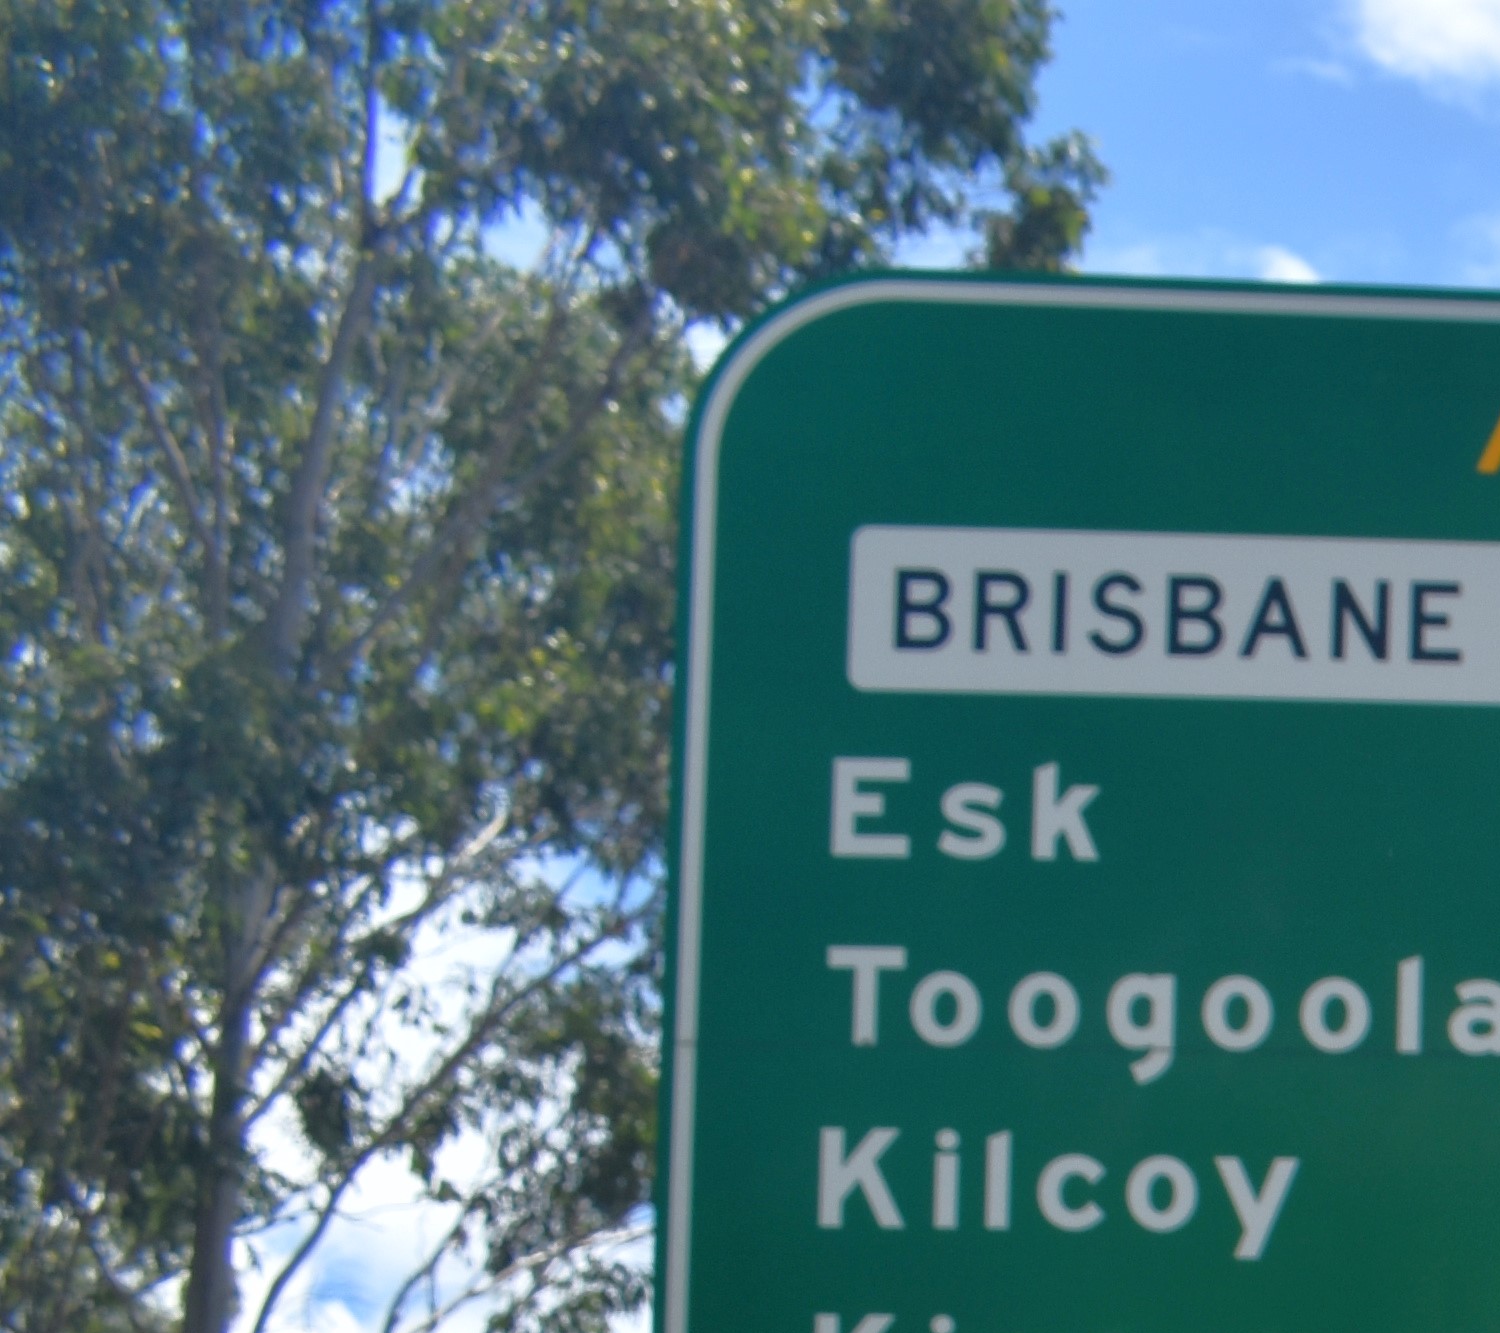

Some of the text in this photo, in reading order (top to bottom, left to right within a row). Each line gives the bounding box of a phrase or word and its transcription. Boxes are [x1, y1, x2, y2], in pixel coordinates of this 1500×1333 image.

[892, 566, 1462, 664] BRISBANE
[829, 755, 1099, 862] Esk
[816, 1125, 1299, 1261] Kilcoy
